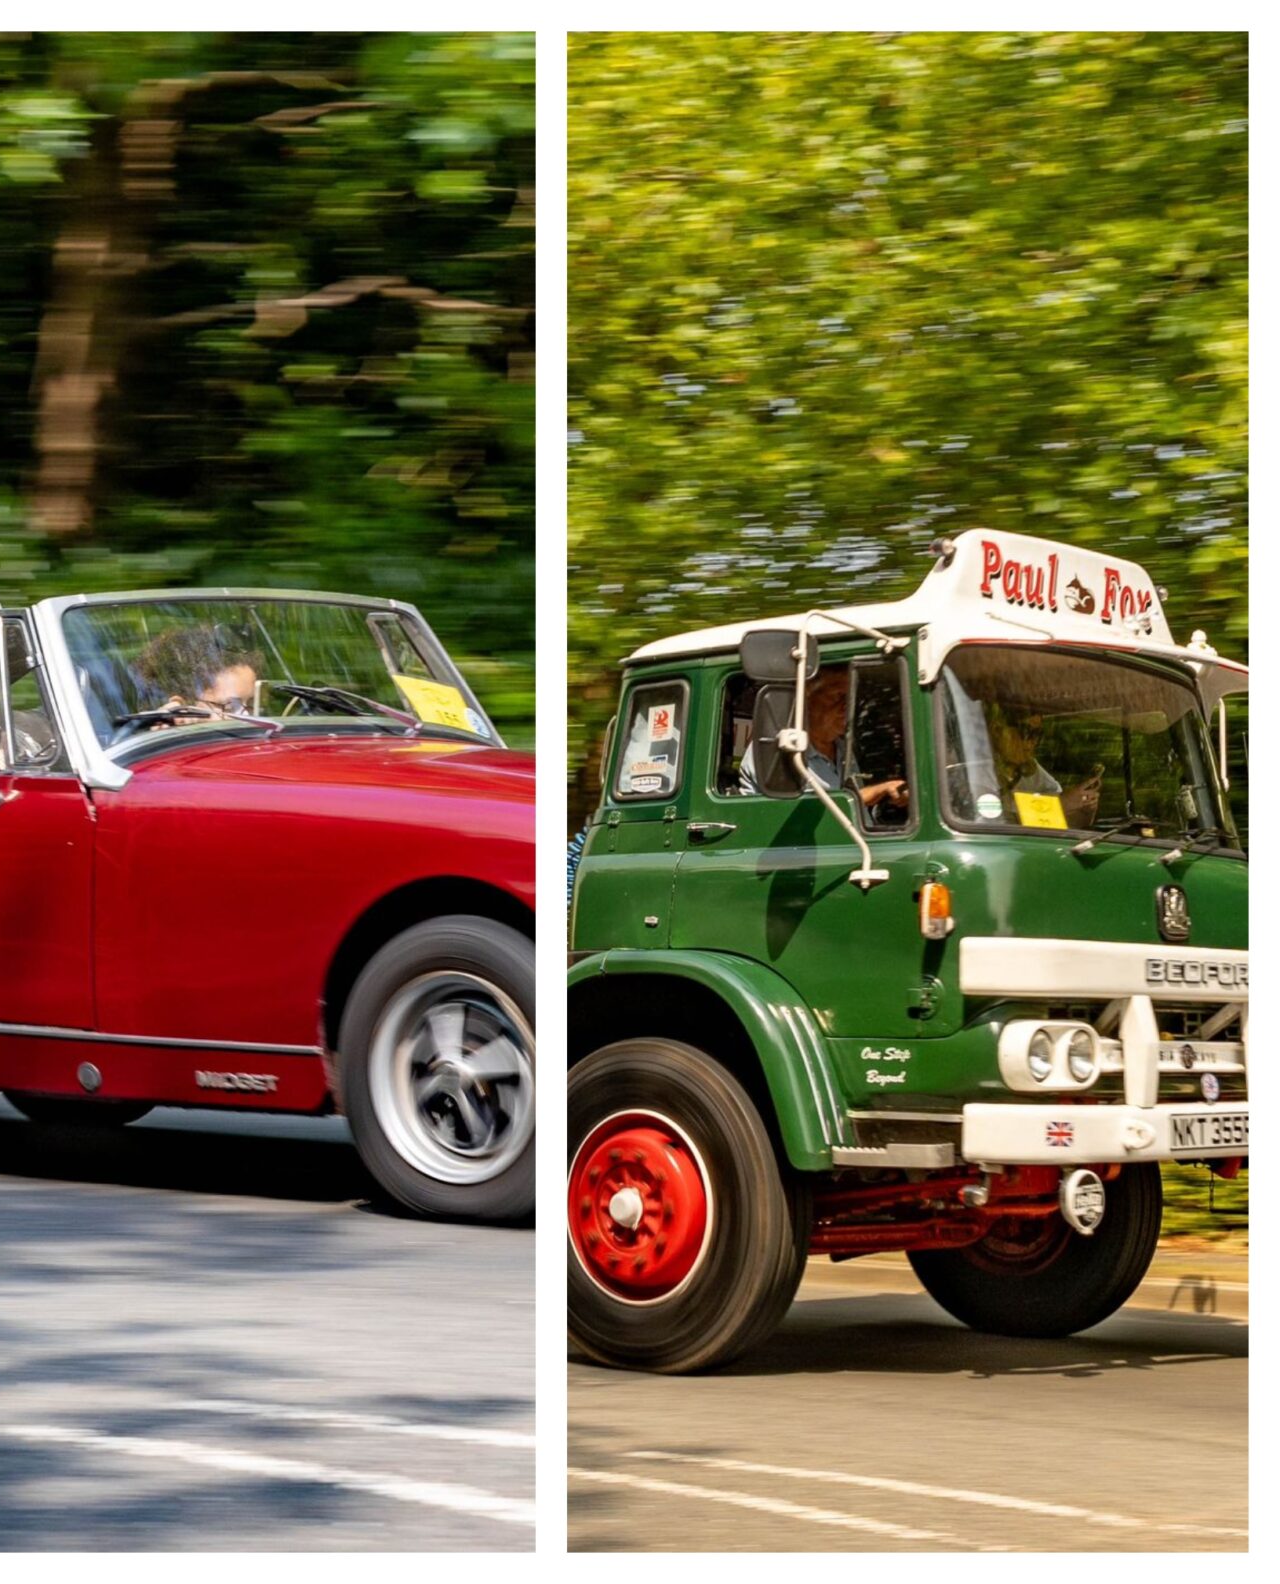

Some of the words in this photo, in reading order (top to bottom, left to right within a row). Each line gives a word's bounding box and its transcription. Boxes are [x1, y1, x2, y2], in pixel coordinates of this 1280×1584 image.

[980, 540, 1058, 612] Paul
[1101, 567, 1153, 635] Fox
[861, 1047, 881, 1059] One
[883, 1047, 911, 1062] Step
[195, 1070, 279, 1091] MIDGET
[866, 1069, 906, 1087] Beyond
[1172, 1118, 1206, 1146] NKT
